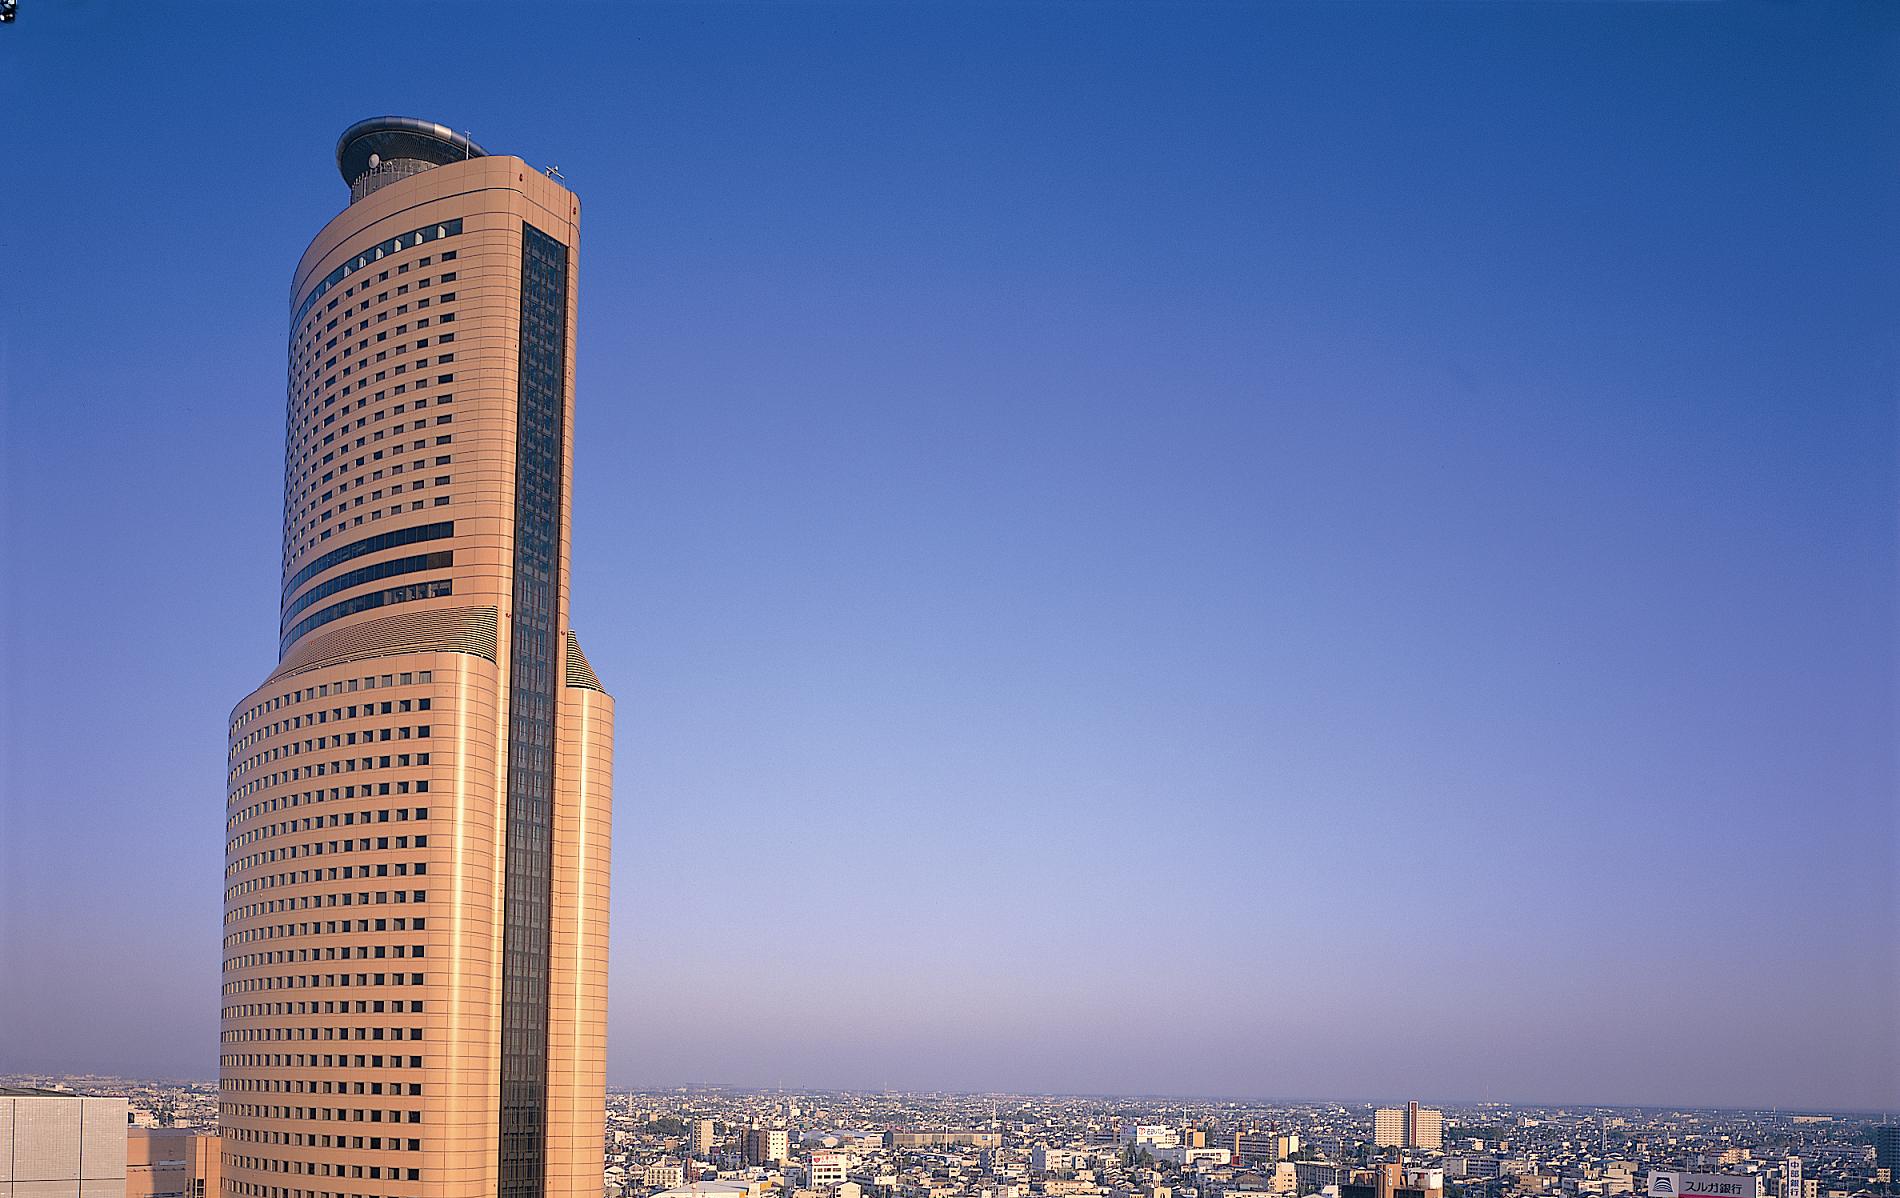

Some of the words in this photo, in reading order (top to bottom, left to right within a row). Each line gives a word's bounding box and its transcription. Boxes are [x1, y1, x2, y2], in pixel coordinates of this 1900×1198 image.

[1685, 1181, 1743, 1195] スルガ銀行
